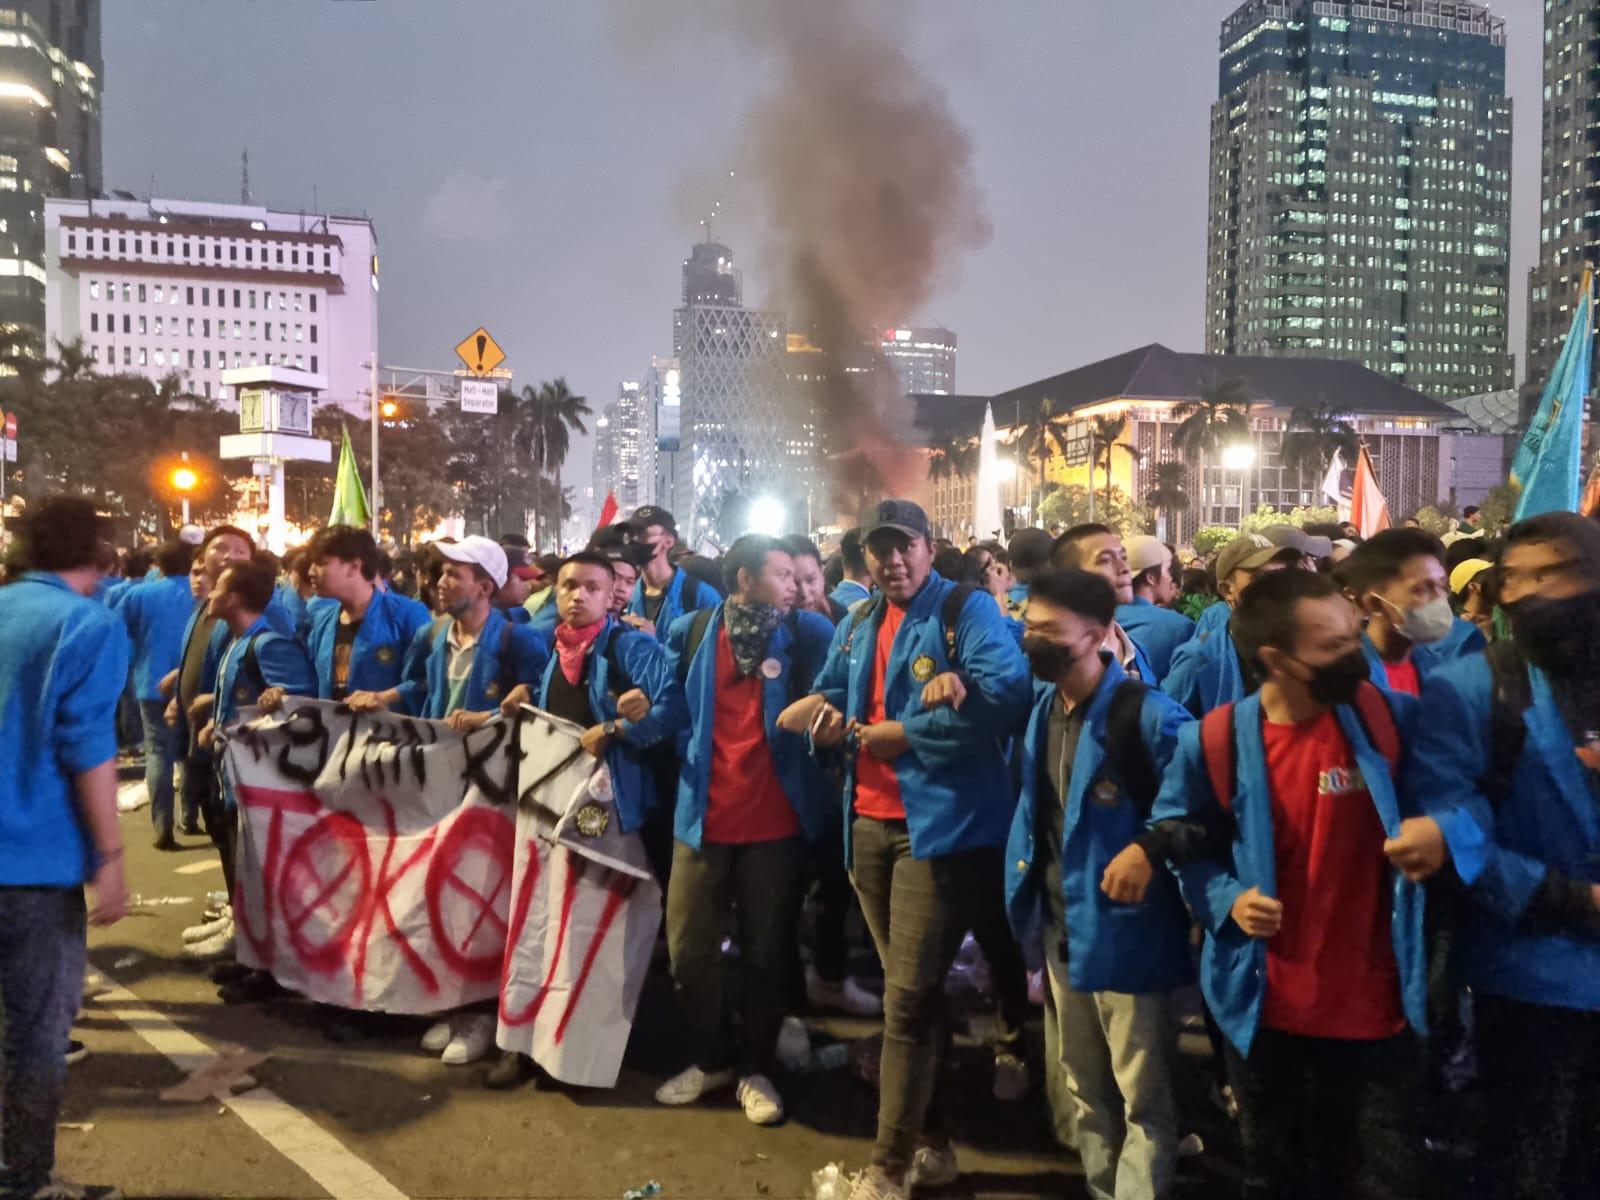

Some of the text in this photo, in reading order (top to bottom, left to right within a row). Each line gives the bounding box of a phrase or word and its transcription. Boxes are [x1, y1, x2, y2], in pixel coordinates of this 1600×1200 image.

[464, 384, 477, 394] Hati
[482, 386, 495, 396] Hati
[463, 397, 495, 408] Separator
